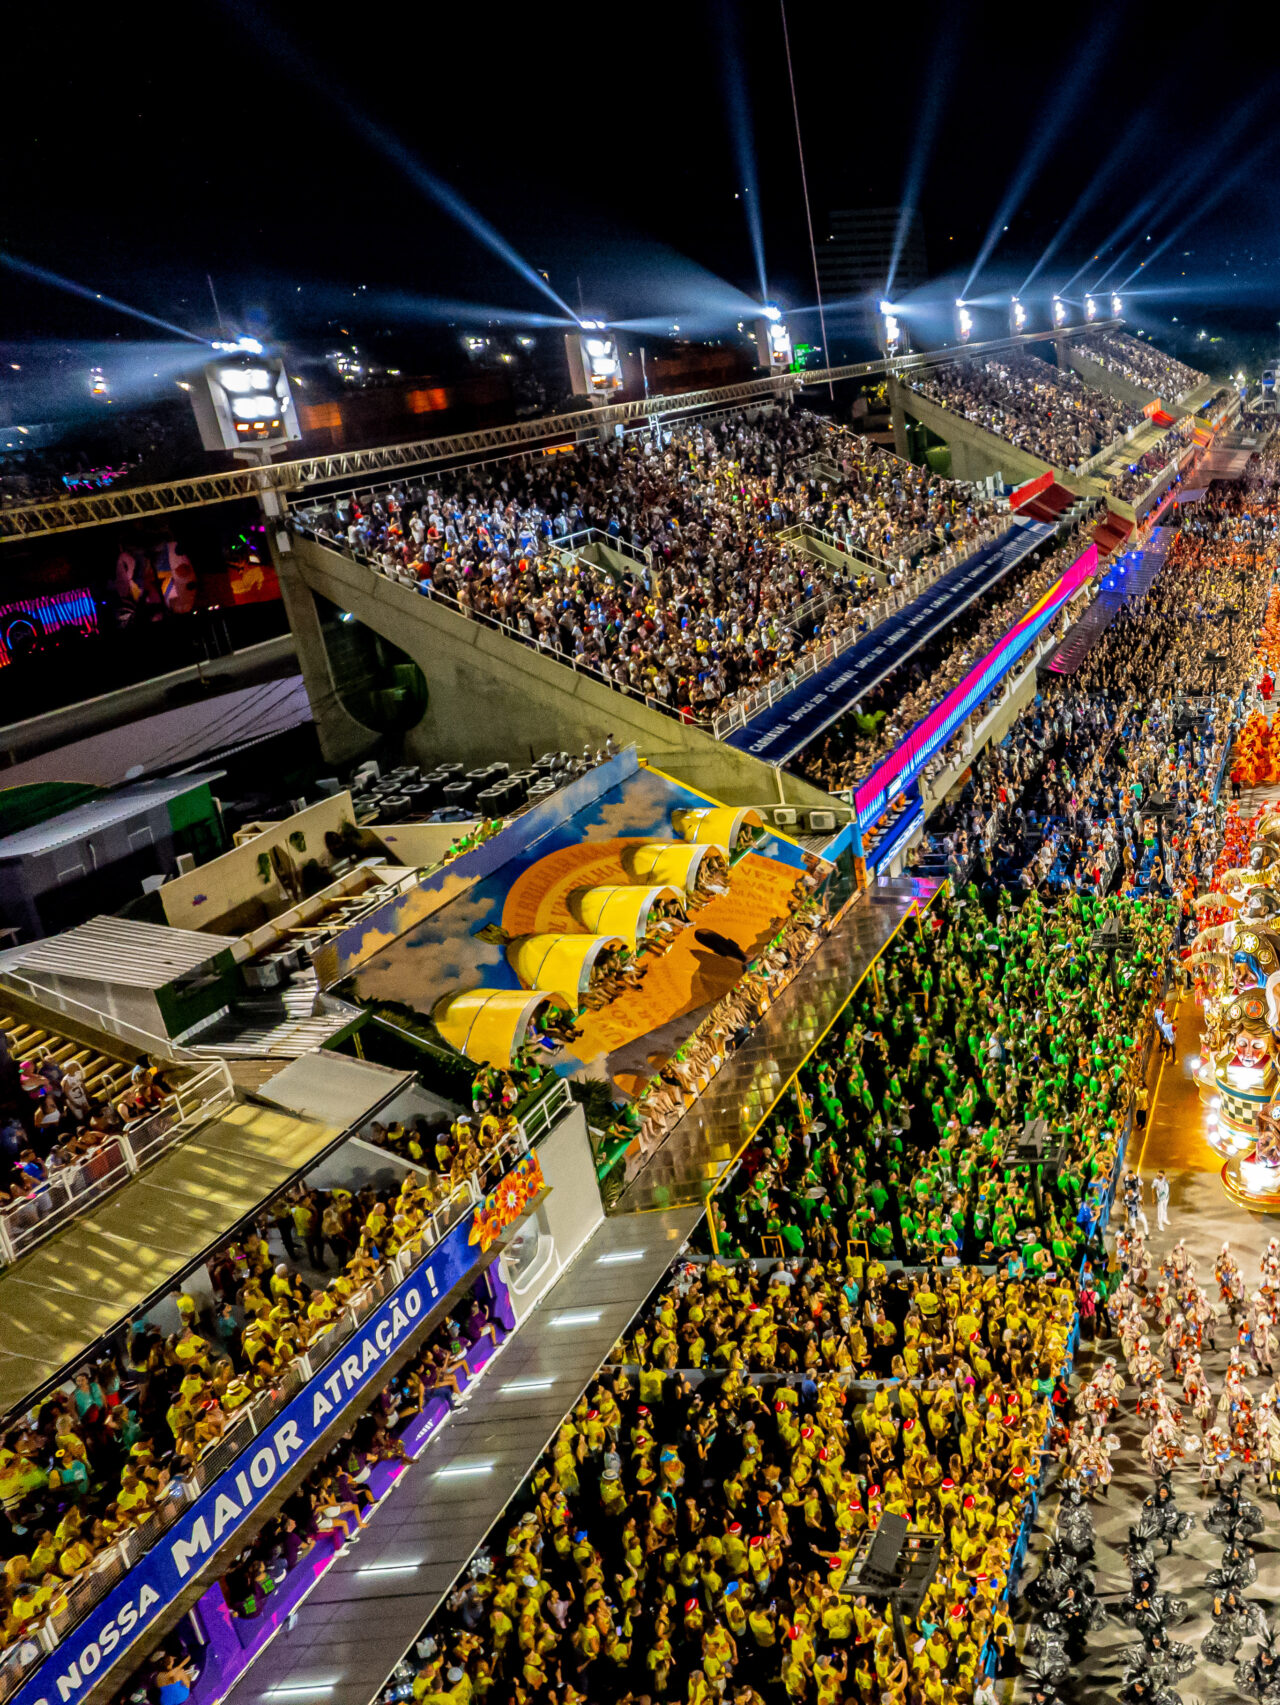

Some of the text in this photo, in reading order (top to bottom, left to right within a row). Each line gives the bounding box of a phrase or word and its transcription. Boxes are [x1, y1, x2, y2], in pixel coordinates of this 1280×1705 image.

[748, 723, 791, 753] CARNAVAL
[56, 1584, 160, 1702] NOSSA
[171, 1420, 304, 1580] MAIOR
[311, 1287, 423, 1428] ATRAÇÃO
